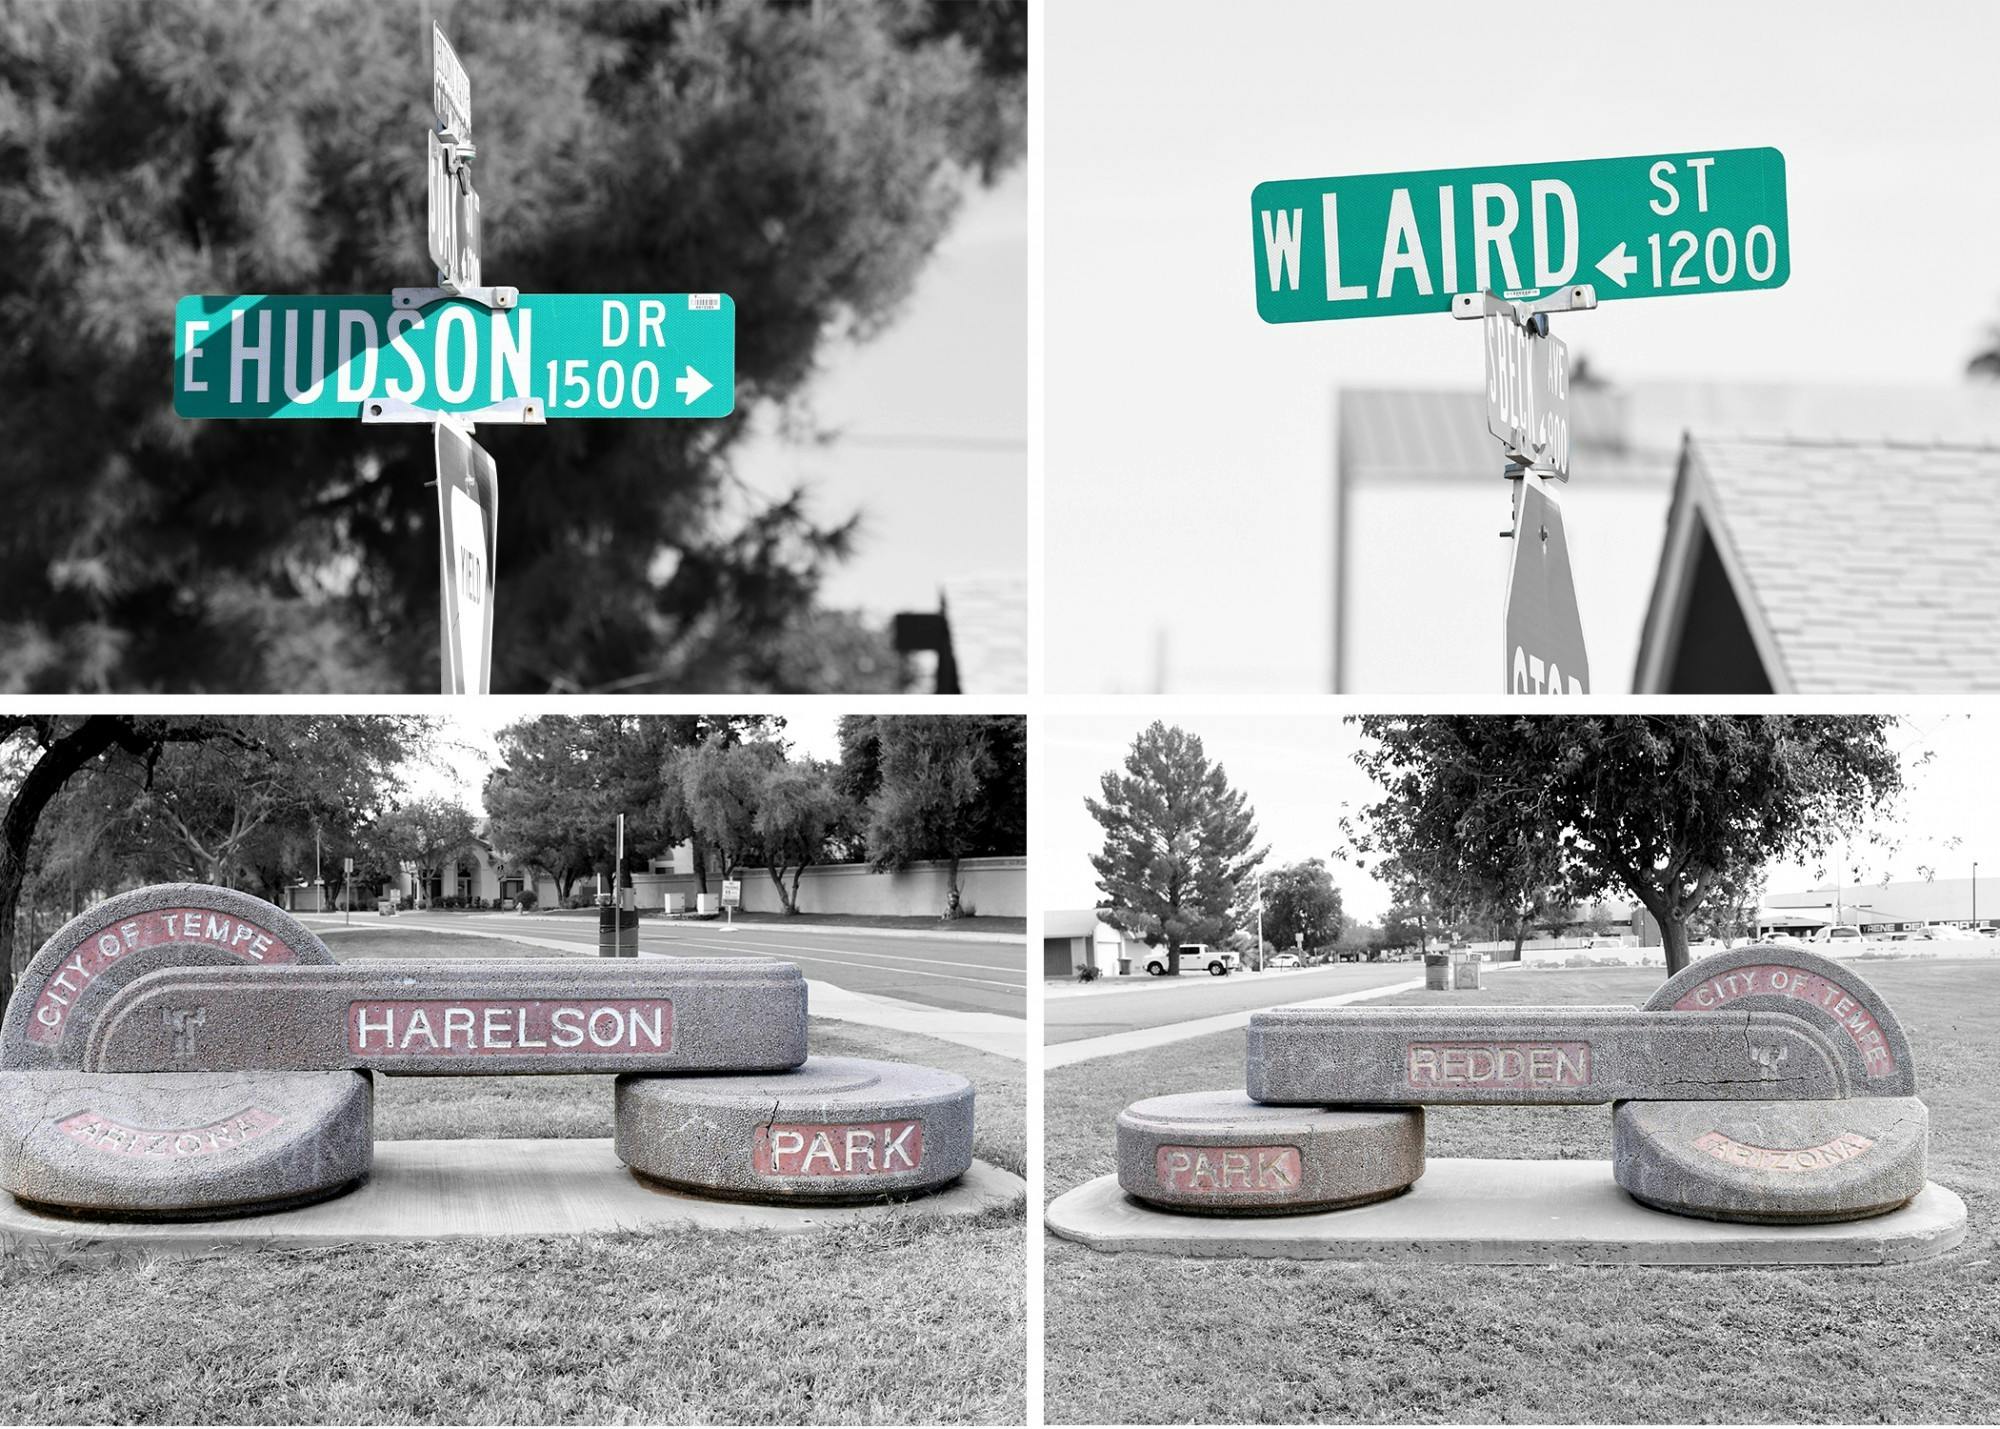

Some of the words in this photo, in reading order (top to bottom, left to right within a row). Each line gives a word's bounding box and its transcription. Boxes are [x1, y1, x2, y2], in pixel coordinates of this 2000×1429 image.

[1649, 157, 1715, 216] ST
[1261, 208, 1303, 292] W
[1322, 179, 1580, 302] LAIRD
[1647, 225, 1777, 288] 1200
[602, 300, 667, 348] DR
[183, 321, 209, 392] E
[229, 306, 532, 405] HUDSON
[546, 360, 660, 410] 1500
[1488, 316, 1497, 403] S
[1496, 310, 1536, 445] BECK
[1548, 337, 1565, 400] AVE
[460, 544, 480, 605] YIELD
[37, 955, 90, 1027] CITY
[99, 922, 140, 958] OF
[161, 912, 273, 961] TEMPE
[358, 1006, 664, 1050] HARELSON
[1696, 970, 1758, 1008] CITY
[1771, 970, 1809, 997] OF
[1824, 985, 1888, 1068] TEMPE
[1410, 1046, 1586, 1084] REDDEN
[76, 1117, 259, 1156] ARIZONA
[771, 1124, 916, 1174] PARK
[1706, 1138, 1863, 1170] ARIZONA
[1169, 1149, 1291, 1190] PARK
